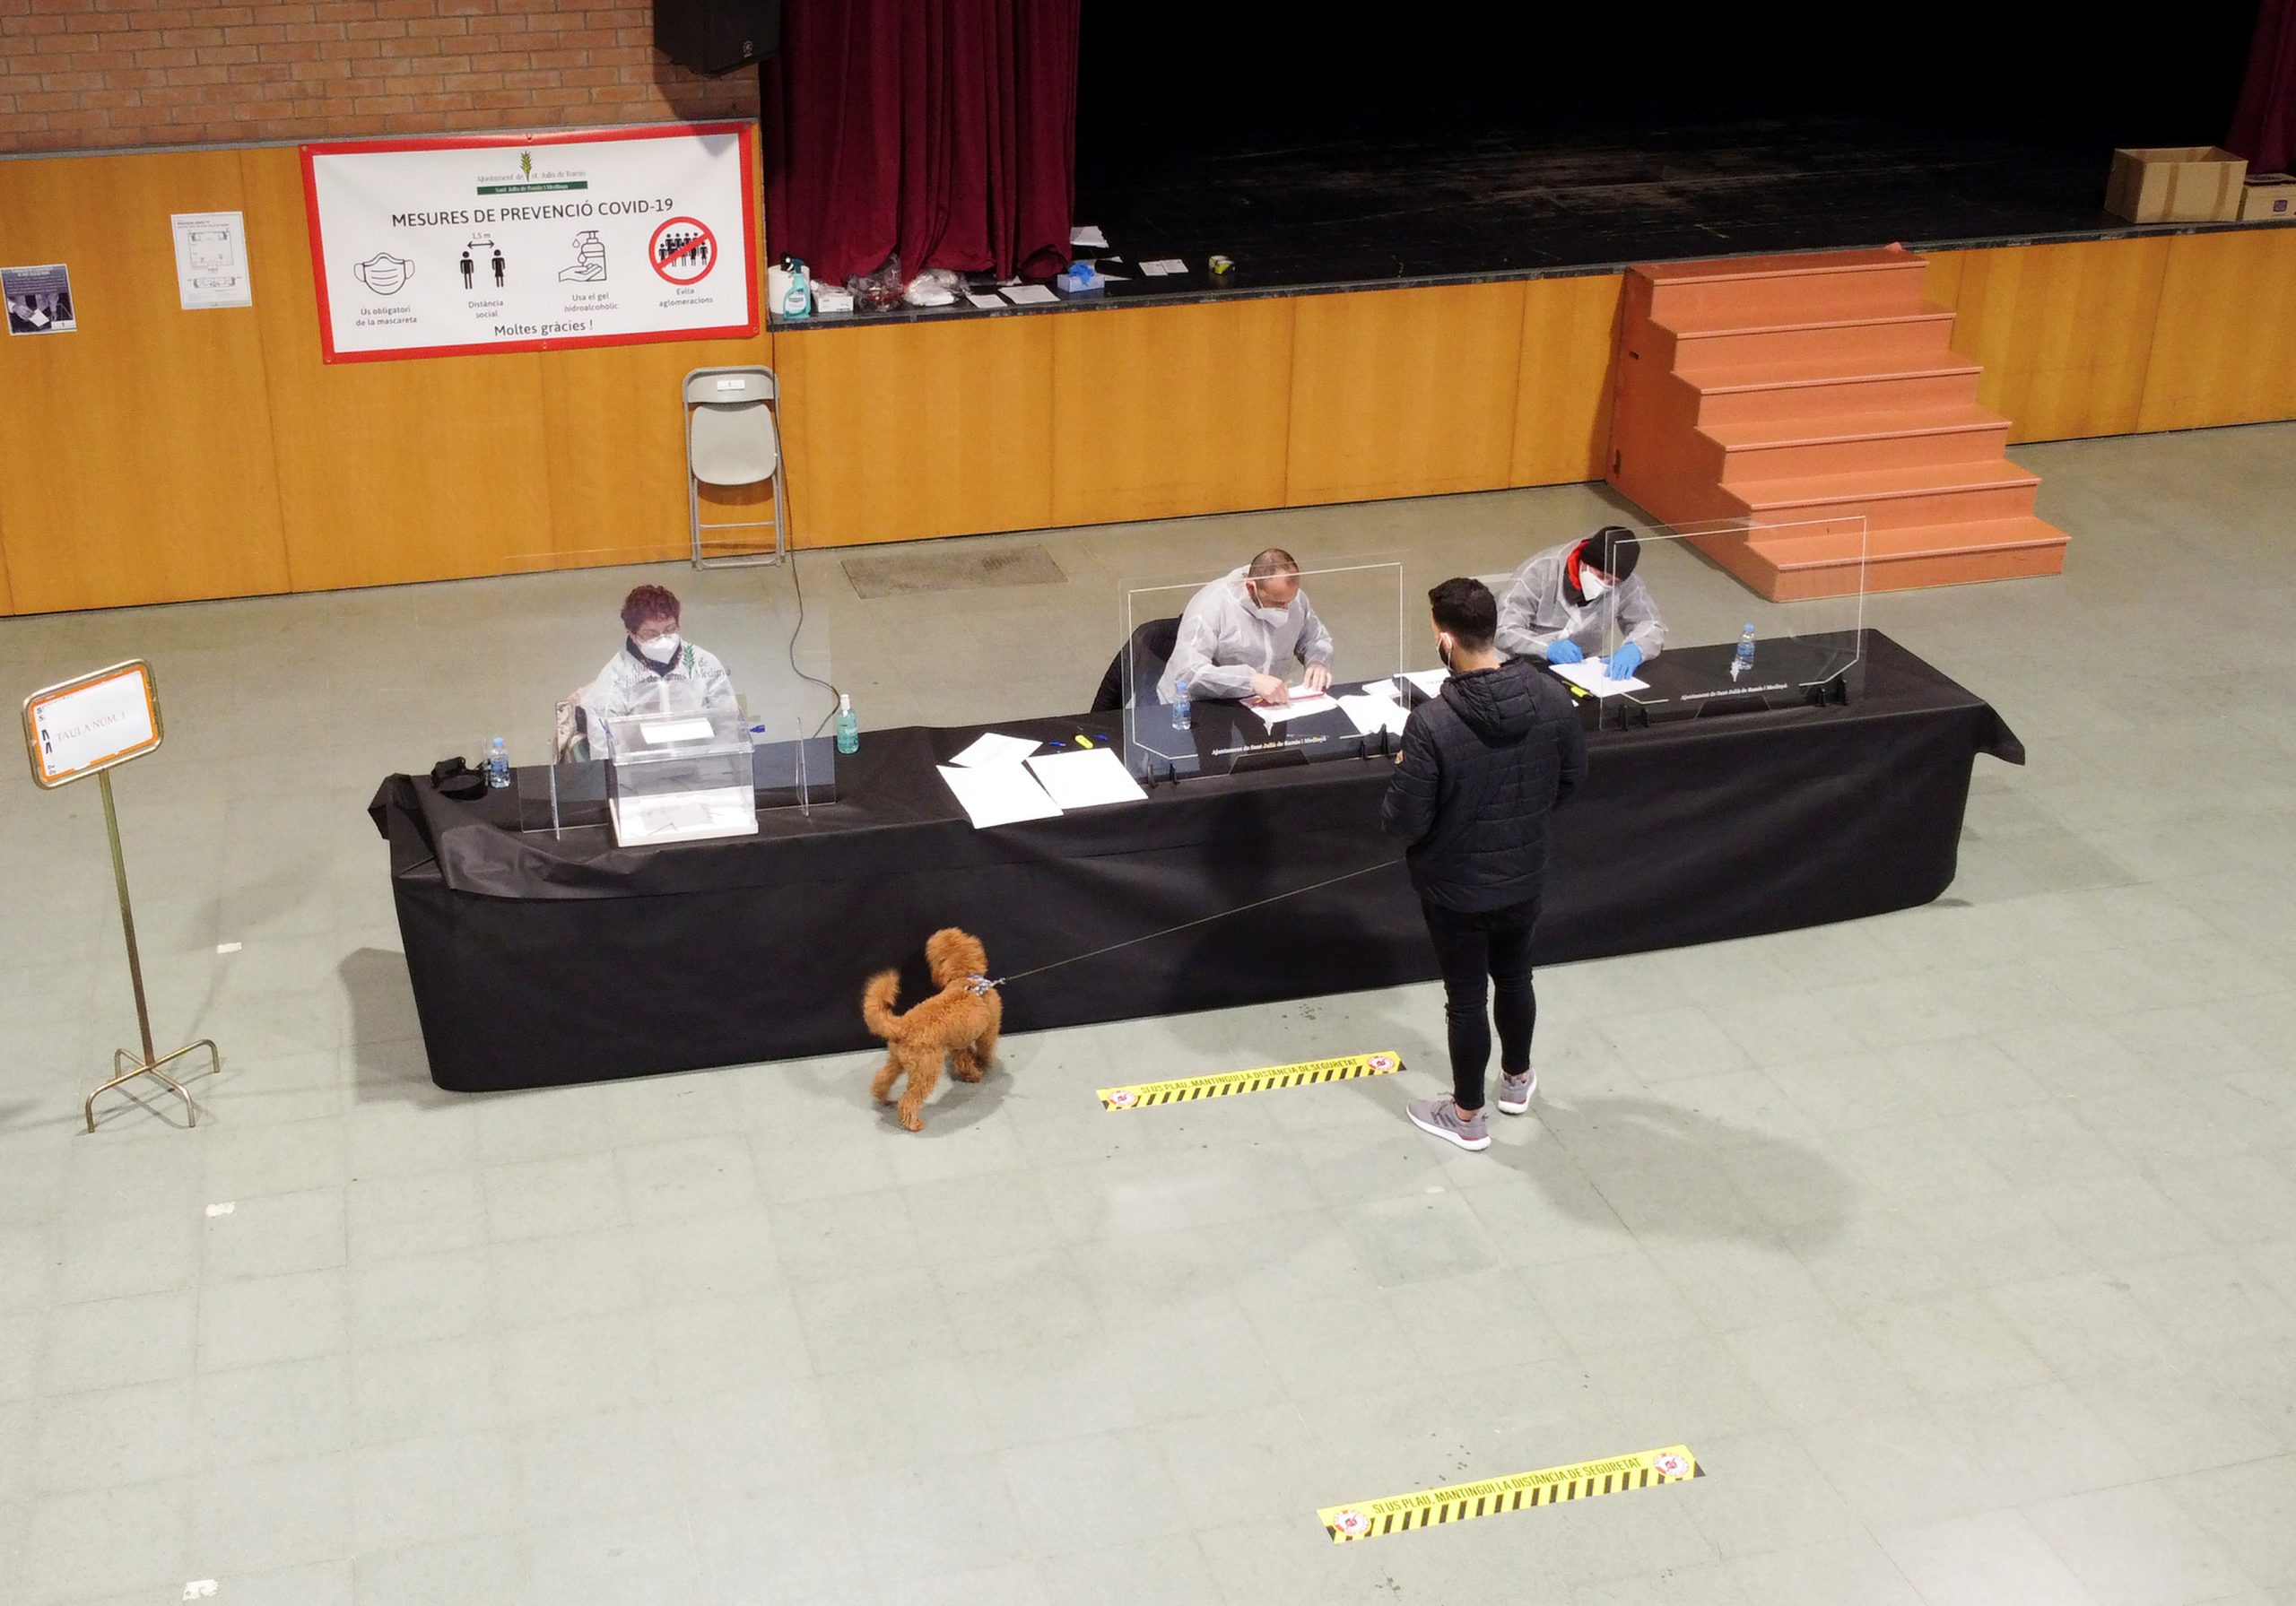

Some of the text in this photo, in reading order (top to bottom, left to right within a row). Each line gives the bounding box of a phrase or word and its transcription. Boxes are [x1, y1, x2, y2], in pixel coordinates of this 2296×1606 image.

[392, 197, 674, 227] MESURES DE PREVENCIÓ COVID-19
[571, 291, 610, 302] Usa el gel
[676, 287, 695, 295] Evita
[468, 299, 504, 308] Distància
[563, 302, 619, 313] hidroalcohòlic
[658, 297, 713, 308] aglomeracions
[372, 305, 411, 317] obligatori
[475, 310, 498, 318] social
[355, 317, 418, 326] de la mascareta
[494, 318, 594, 336] Moltes gràcies !
[57, 724, 92, 742] TAULA
[1140, 1086, 1150, 1094] SI
[1151, 1084, 1164, 1093] US
[1191, 1076, 1240, 1088] MANTINGUI
[1241, 1073, 1253, 1081] LA
[1300, 1064, 1311, 1072] DE
[1311, 1058, 1358, 1072] SEGURETAT
[1372, 1502, 1386, 1515] SI
[1387, 1500, 1403, 1513] US
[1435, 1483, 1496, 1503] MANTINGUI
[1496, 1481, 1512, 1494] LA
[1512, 1469, 1569, 1489] DISTÀNCIA
[1569, 1467, 1582, 1480] DE
[1582, 1457, 1642, 1478] SEGURETAT
